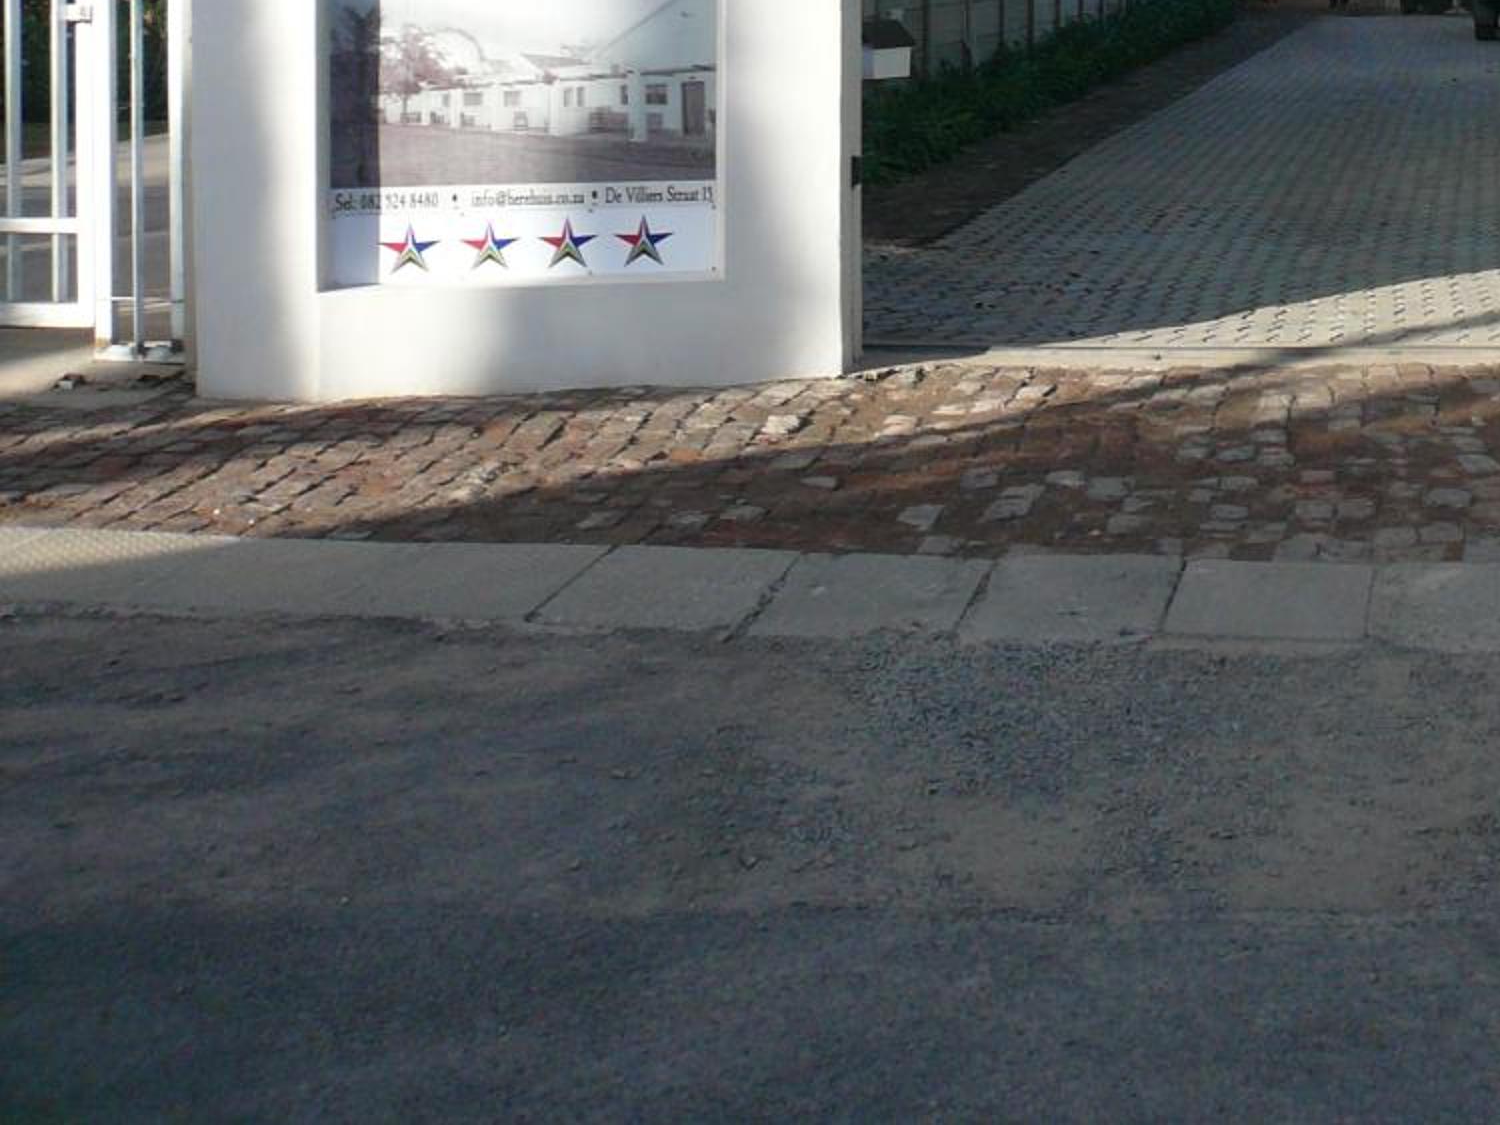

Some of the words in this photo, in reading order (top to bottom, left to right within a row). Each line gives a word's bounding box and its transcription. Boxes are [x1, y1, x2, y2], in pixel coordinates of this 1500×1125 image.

[410, 191, 439, 209] 8480
[604, 186, 623, 204] De
[626, 185, 664, 204] Villiers
[667, 184, 699, 203] Straat
